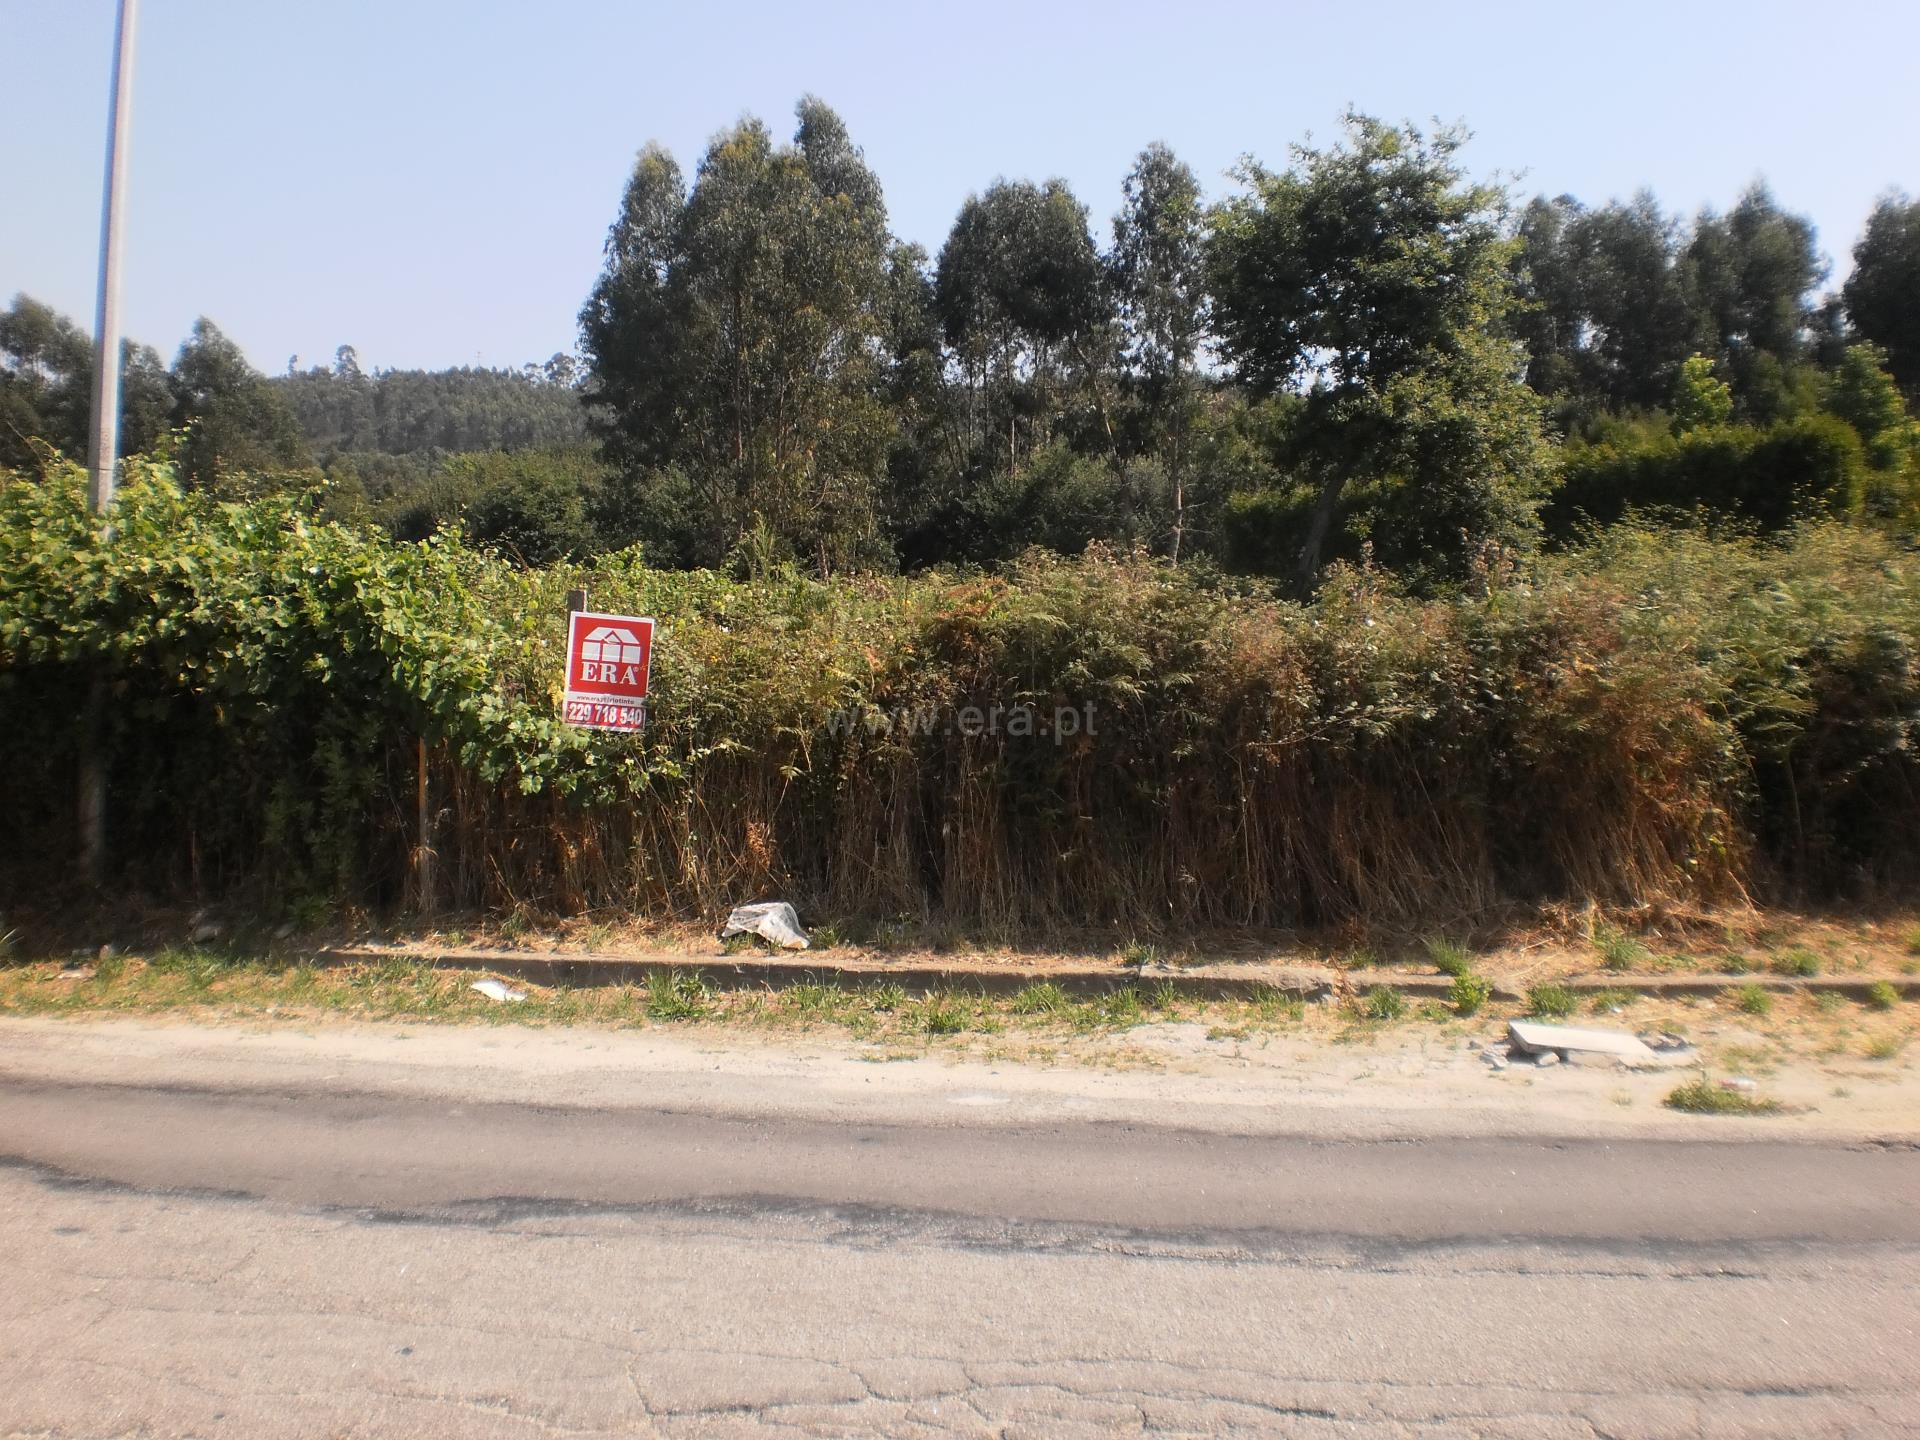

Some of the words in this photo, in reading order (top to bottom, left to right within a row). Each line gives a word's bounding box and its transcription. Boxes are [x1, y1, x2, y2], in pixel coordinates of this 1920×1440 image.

[580, 661, 638, 685] ERA
[568, 703, 591, 721] 229
[595, 705, 617, 723] 718
[620, 708, 642, 725] 540
